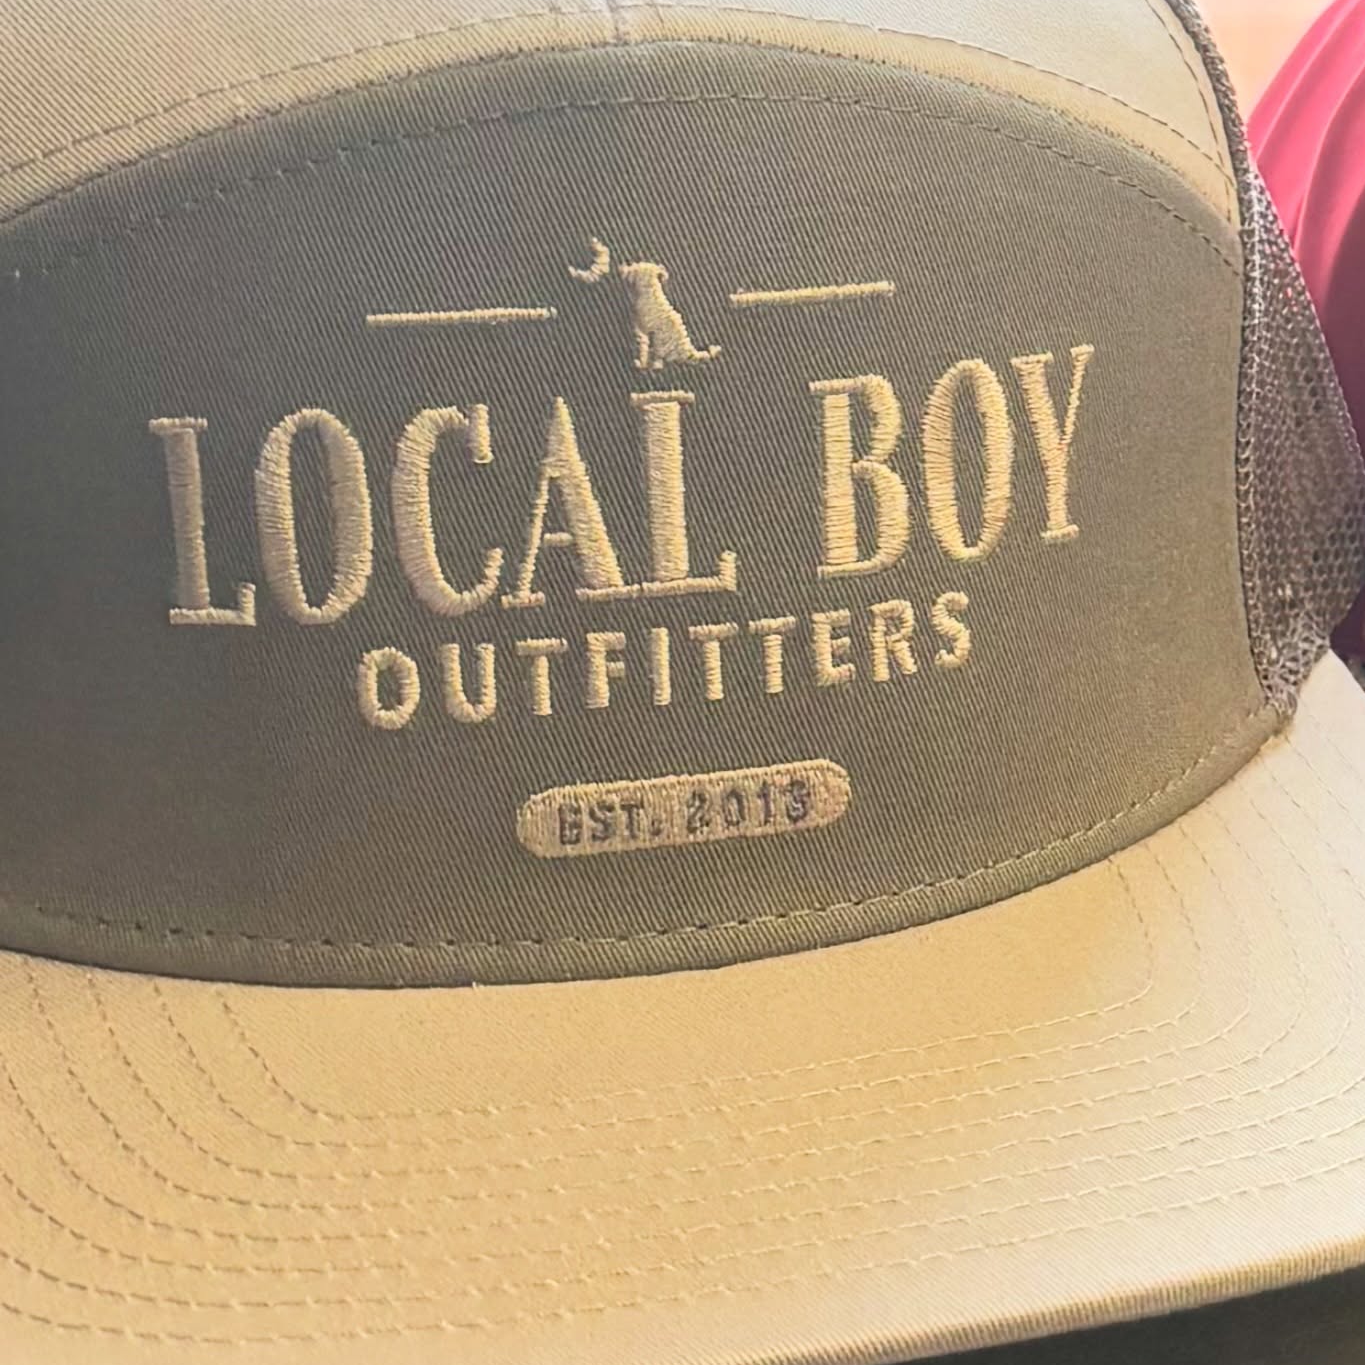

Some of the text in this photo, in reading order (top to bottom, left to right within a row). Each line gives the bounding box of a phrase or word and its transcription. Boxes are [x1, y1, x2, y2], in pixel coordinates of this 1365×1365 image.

[149, 344, 1095, 626] LOCAL BOY
[357, 591, 972, 731] OUTFITTERS
[558, 779, 813, 846] EST. 2013
